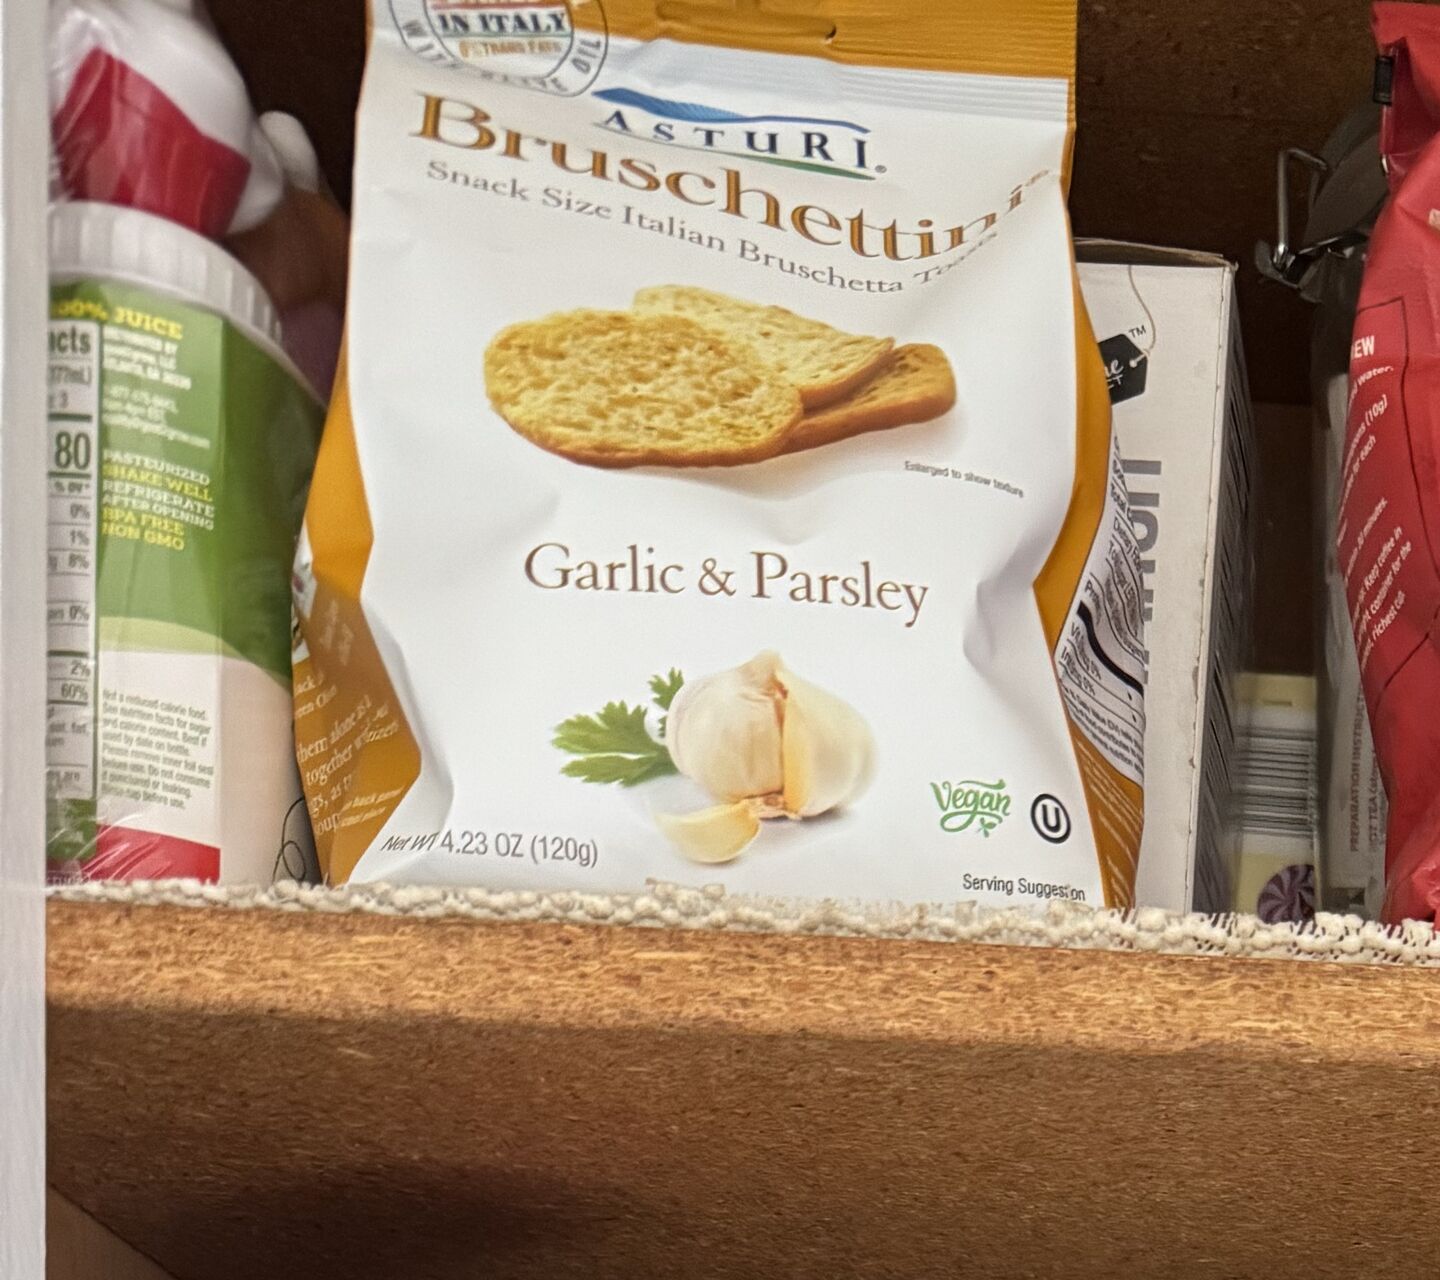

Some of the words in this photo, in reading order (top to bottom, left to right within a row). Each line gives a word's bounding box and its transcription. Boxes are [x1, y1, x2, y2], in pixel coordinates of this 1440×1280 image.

[438, 14, 470, 33] IN
[475, 13, 566, 32] ITALY
[603, 110, 869, 171] ASTURI
[408, 90, 1026, 262] Bruschettini
[427, 160, 530, 202] Snack
[541, 187, 612, 220] Size
[622, 201, 725, 253] Italian
[738, 238, 903, 293] Bruschetta
[115, 307, 183, 340] JUICE
[55, 431, 92, 470] 80
[167, 479, 213, 501] WELL
[152, 502, 214, 531] OPENING
[144, 529, 185, 551] GMO
[524, 540, 684, 595] Garlic
[698, 557, 737, 598] &
[751, 550, 931, 628] Parsley
[929, 778, 1011, 836] Vegan
[441, 828, 488, 857] 4.23
[530, 835, 599, 868] (120g)
[963, 873, 1013, 895] Serving
